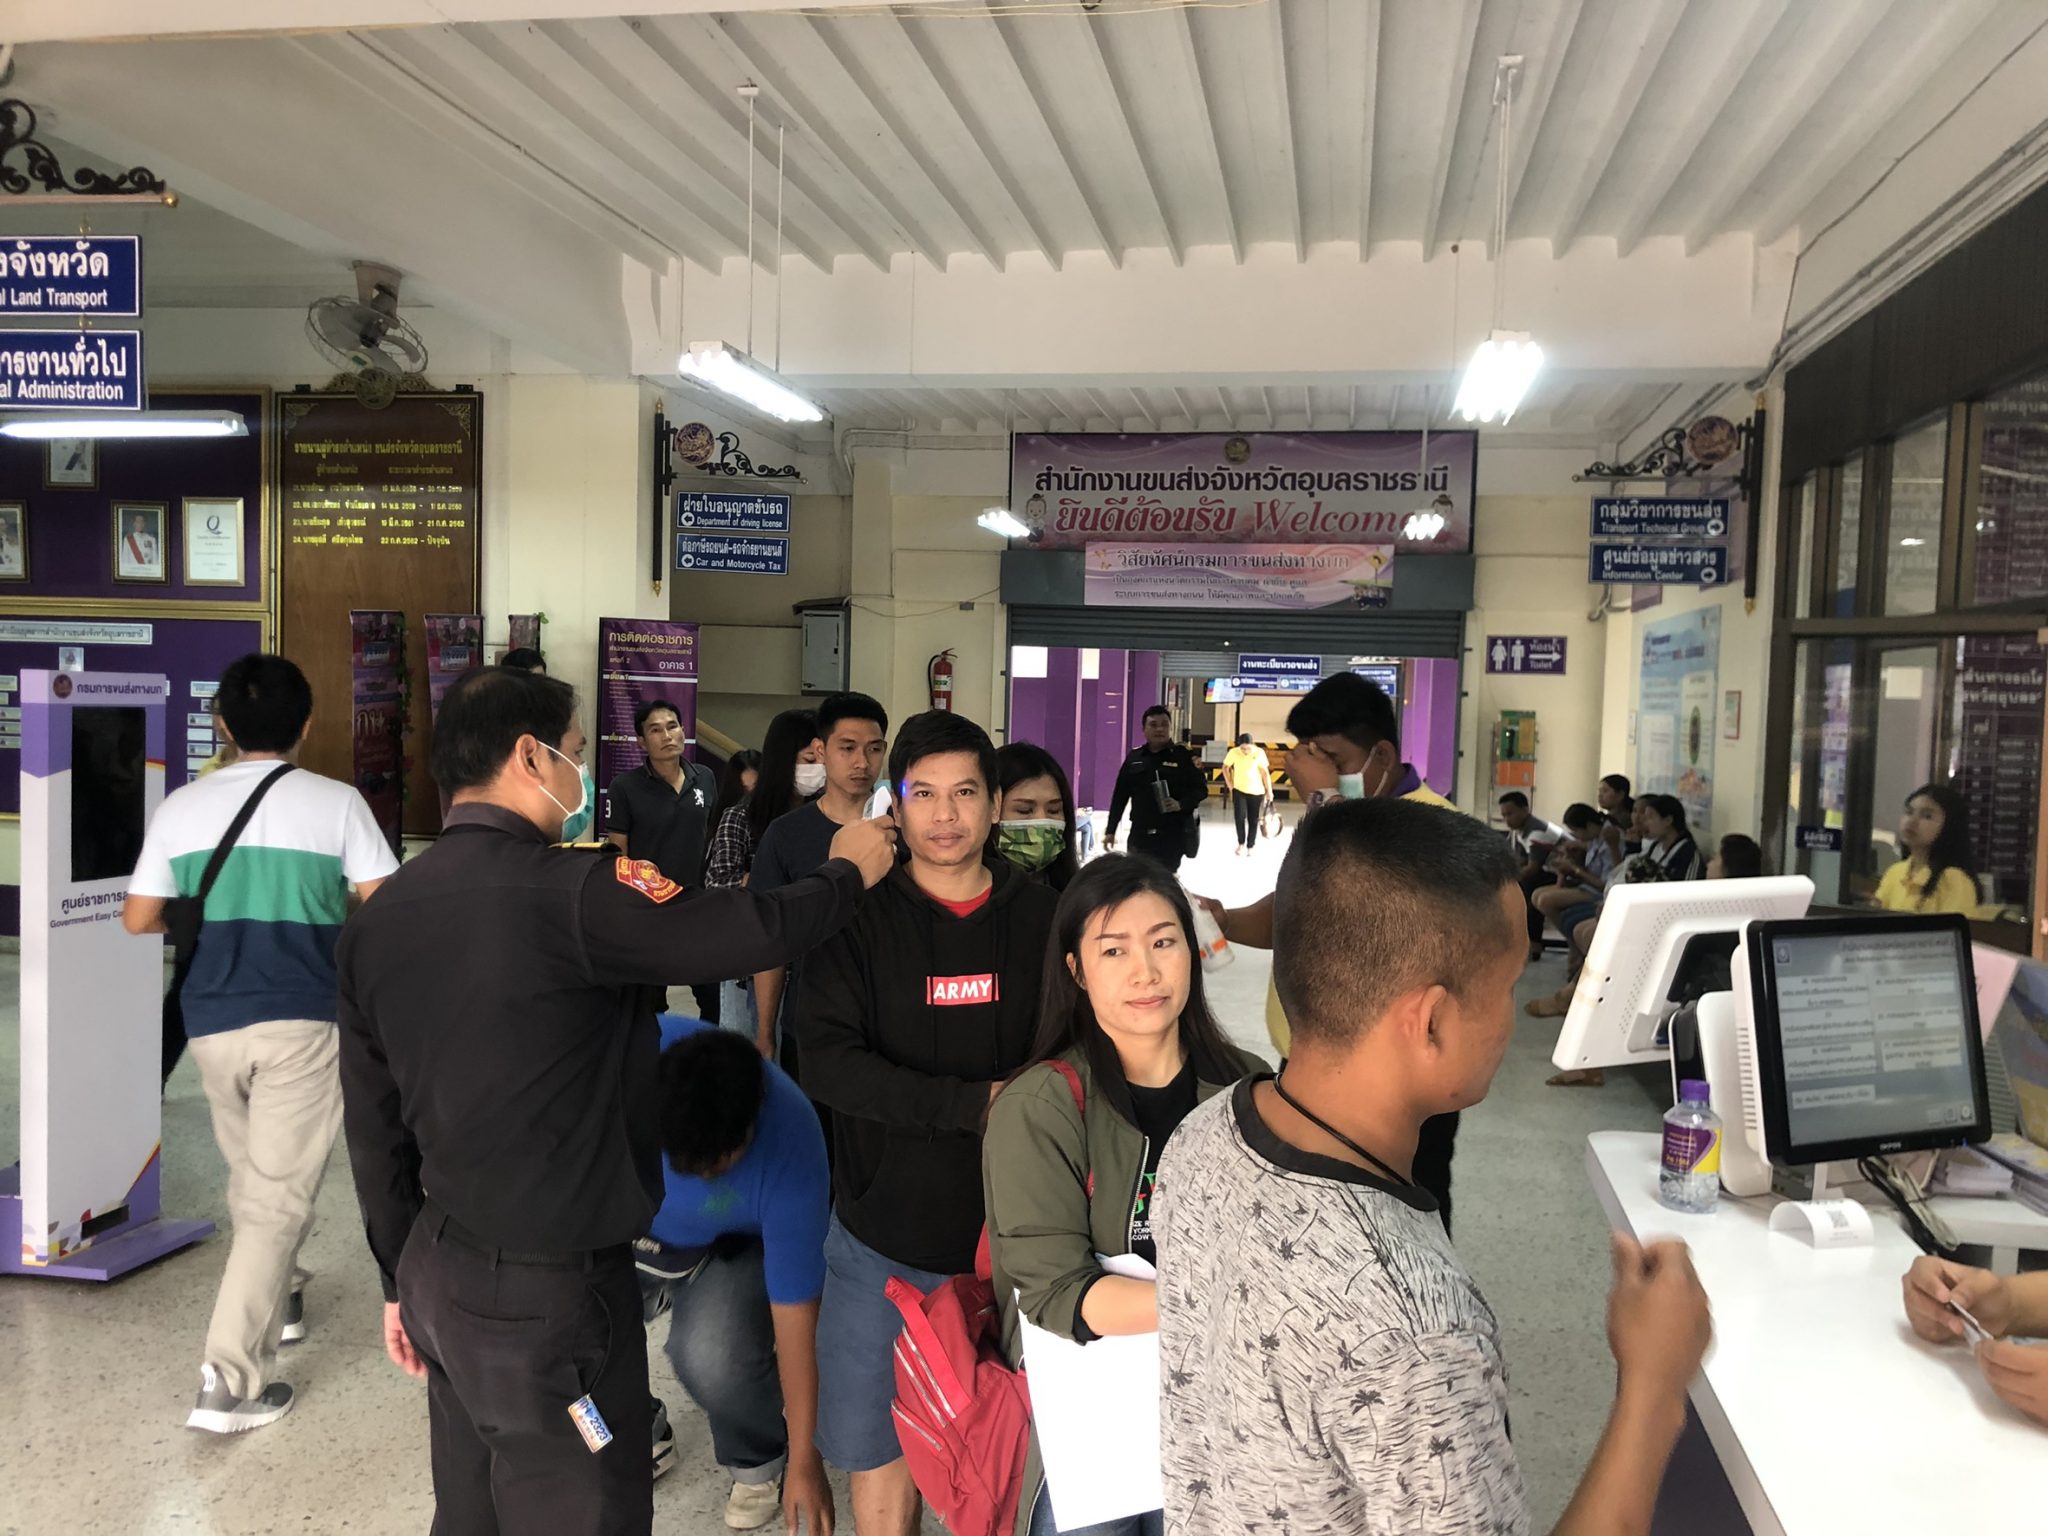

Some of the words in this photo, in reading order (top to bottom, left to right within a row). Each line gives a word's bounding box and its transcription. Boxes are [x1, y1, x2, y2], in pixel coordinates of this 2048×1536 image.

[11, 288, 42, 305] Land
[46, 288, 108, 308] Transport
[0, 336, 126, 377] ารงานทั่วไป
[17, 380, 123, 400] Administration
[1035, 466, 1449, 497] สำนักงานขนส่งจังหวัดอุบลราชธานี
[683, 494, 783, 519] ฝ่ายใบอนุญาตขับรถ
[1055, 495, 1236, 532] ยินดีต้อนรับ
[696, 516, 731, 527] Department
[732, 517, 739, 527] of
[740, 518, 760, 529] driving
[762, 519, 783, 528] license
[695, 558, 708, 567] Car
[711, 559, 724, 568] and
[727, 560, 766, 572] Motorcycle
[768, 562, 781, 570] Tax
[609, 631, 694, 645] การติดต่อราชการ
[659, 661, 685, 670] อาคาร
[688, 662, 693, 670] 1
[77, 682, 163, 694] กรมการขนส่งทางบก
[50, 915, 94, 928] Government
[95, 912, 112, 921] Easy
[933, 979, 992, 1000] ARMY
[589, 1416, 609, 1441] 2323
